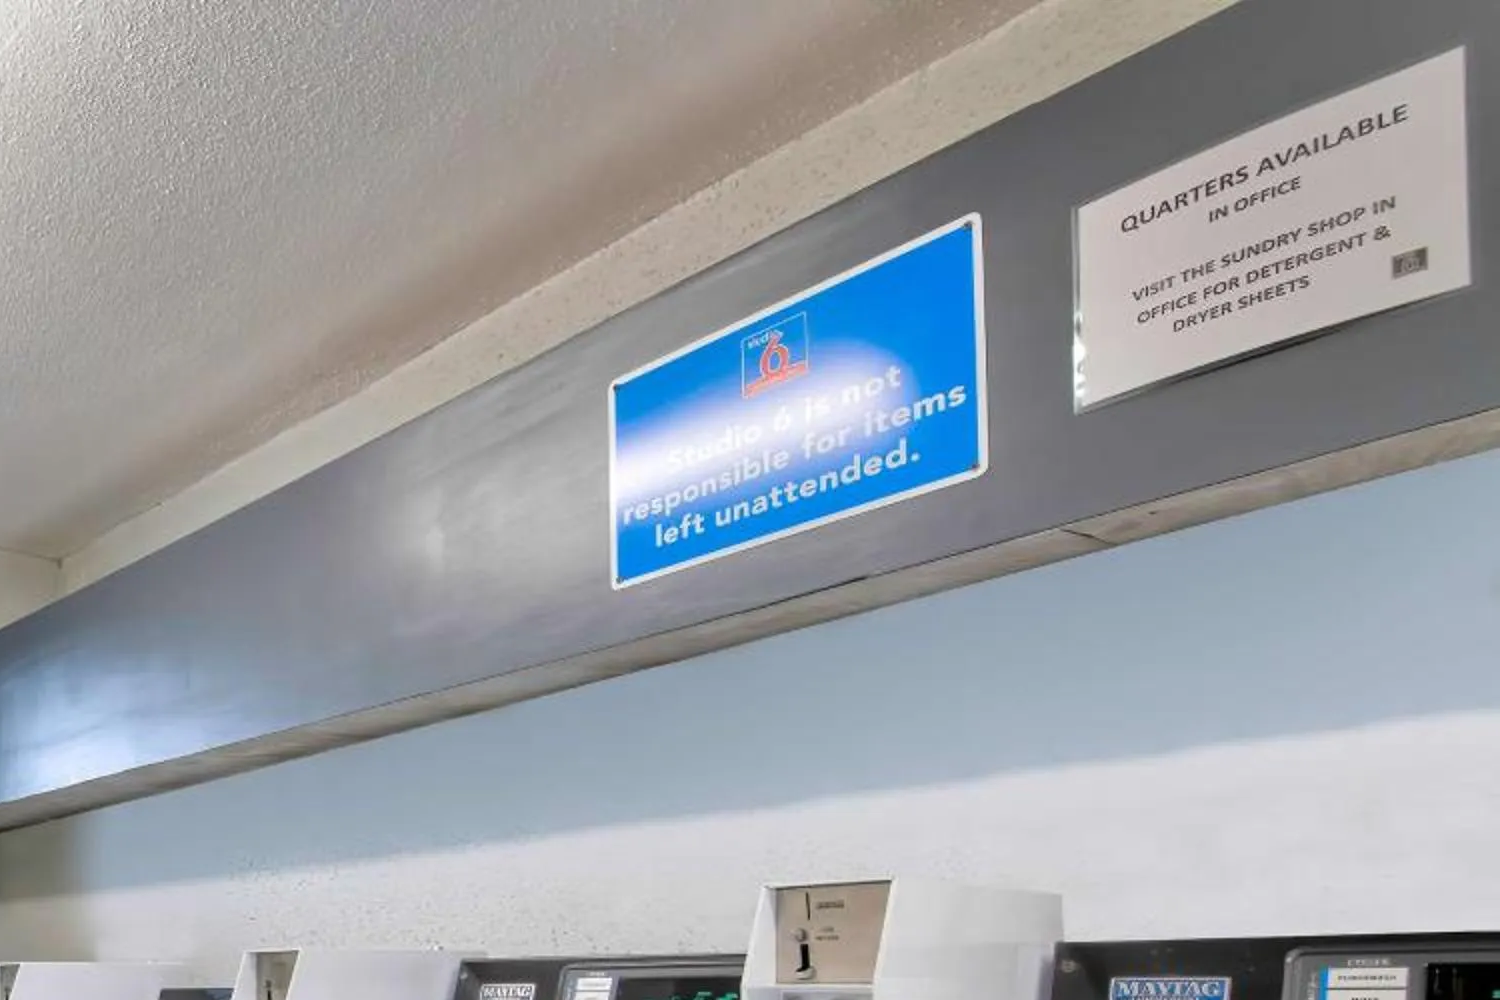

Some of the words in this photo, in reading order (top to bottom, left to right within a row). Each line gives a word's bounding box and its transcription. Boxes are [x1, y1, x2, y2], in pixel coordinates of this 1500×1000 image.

[1120, 166, 1249, 233] QUARTERS
[1256, 104, 1409, 176] AVAILABLE
[1208, 205, 1229, 224] IN
[1233, 176, 1301, 212] OFFICE
[1132, 275, 1176, 302] VISIT
[1180, 261, 1216, 283] THE
[1221, 228, 1301, 268] SUNDRY
[1307, 206, 1366, 237] SHOP
[1372, 196, 1397, 216] IN
[1137, 292, 1197, 324] OFFICE
[1203, 277, 1241, 300] FOR
[1246, 232, 1367, 285] DETERGENT
[1373, 225, 1392, 242] &
[1173, 302, 1232, 333] DRYER
[1237, 275, 1311, 309] SHEETS
[621, 447, 790, 526] responsible
[802, 422, 850, 461] for
[863, 384, 967, 437] items
[667, 424, 761, 474] Studio
[773, 405, 792, 433] 6
[803, 392, 834, 424] is
[841, 365, 902, 406] not
[655, 513, 705, 548] left
[715, 440, 922, 528] unattended.
[1115, 981, 1221, 998] MAYTAG
